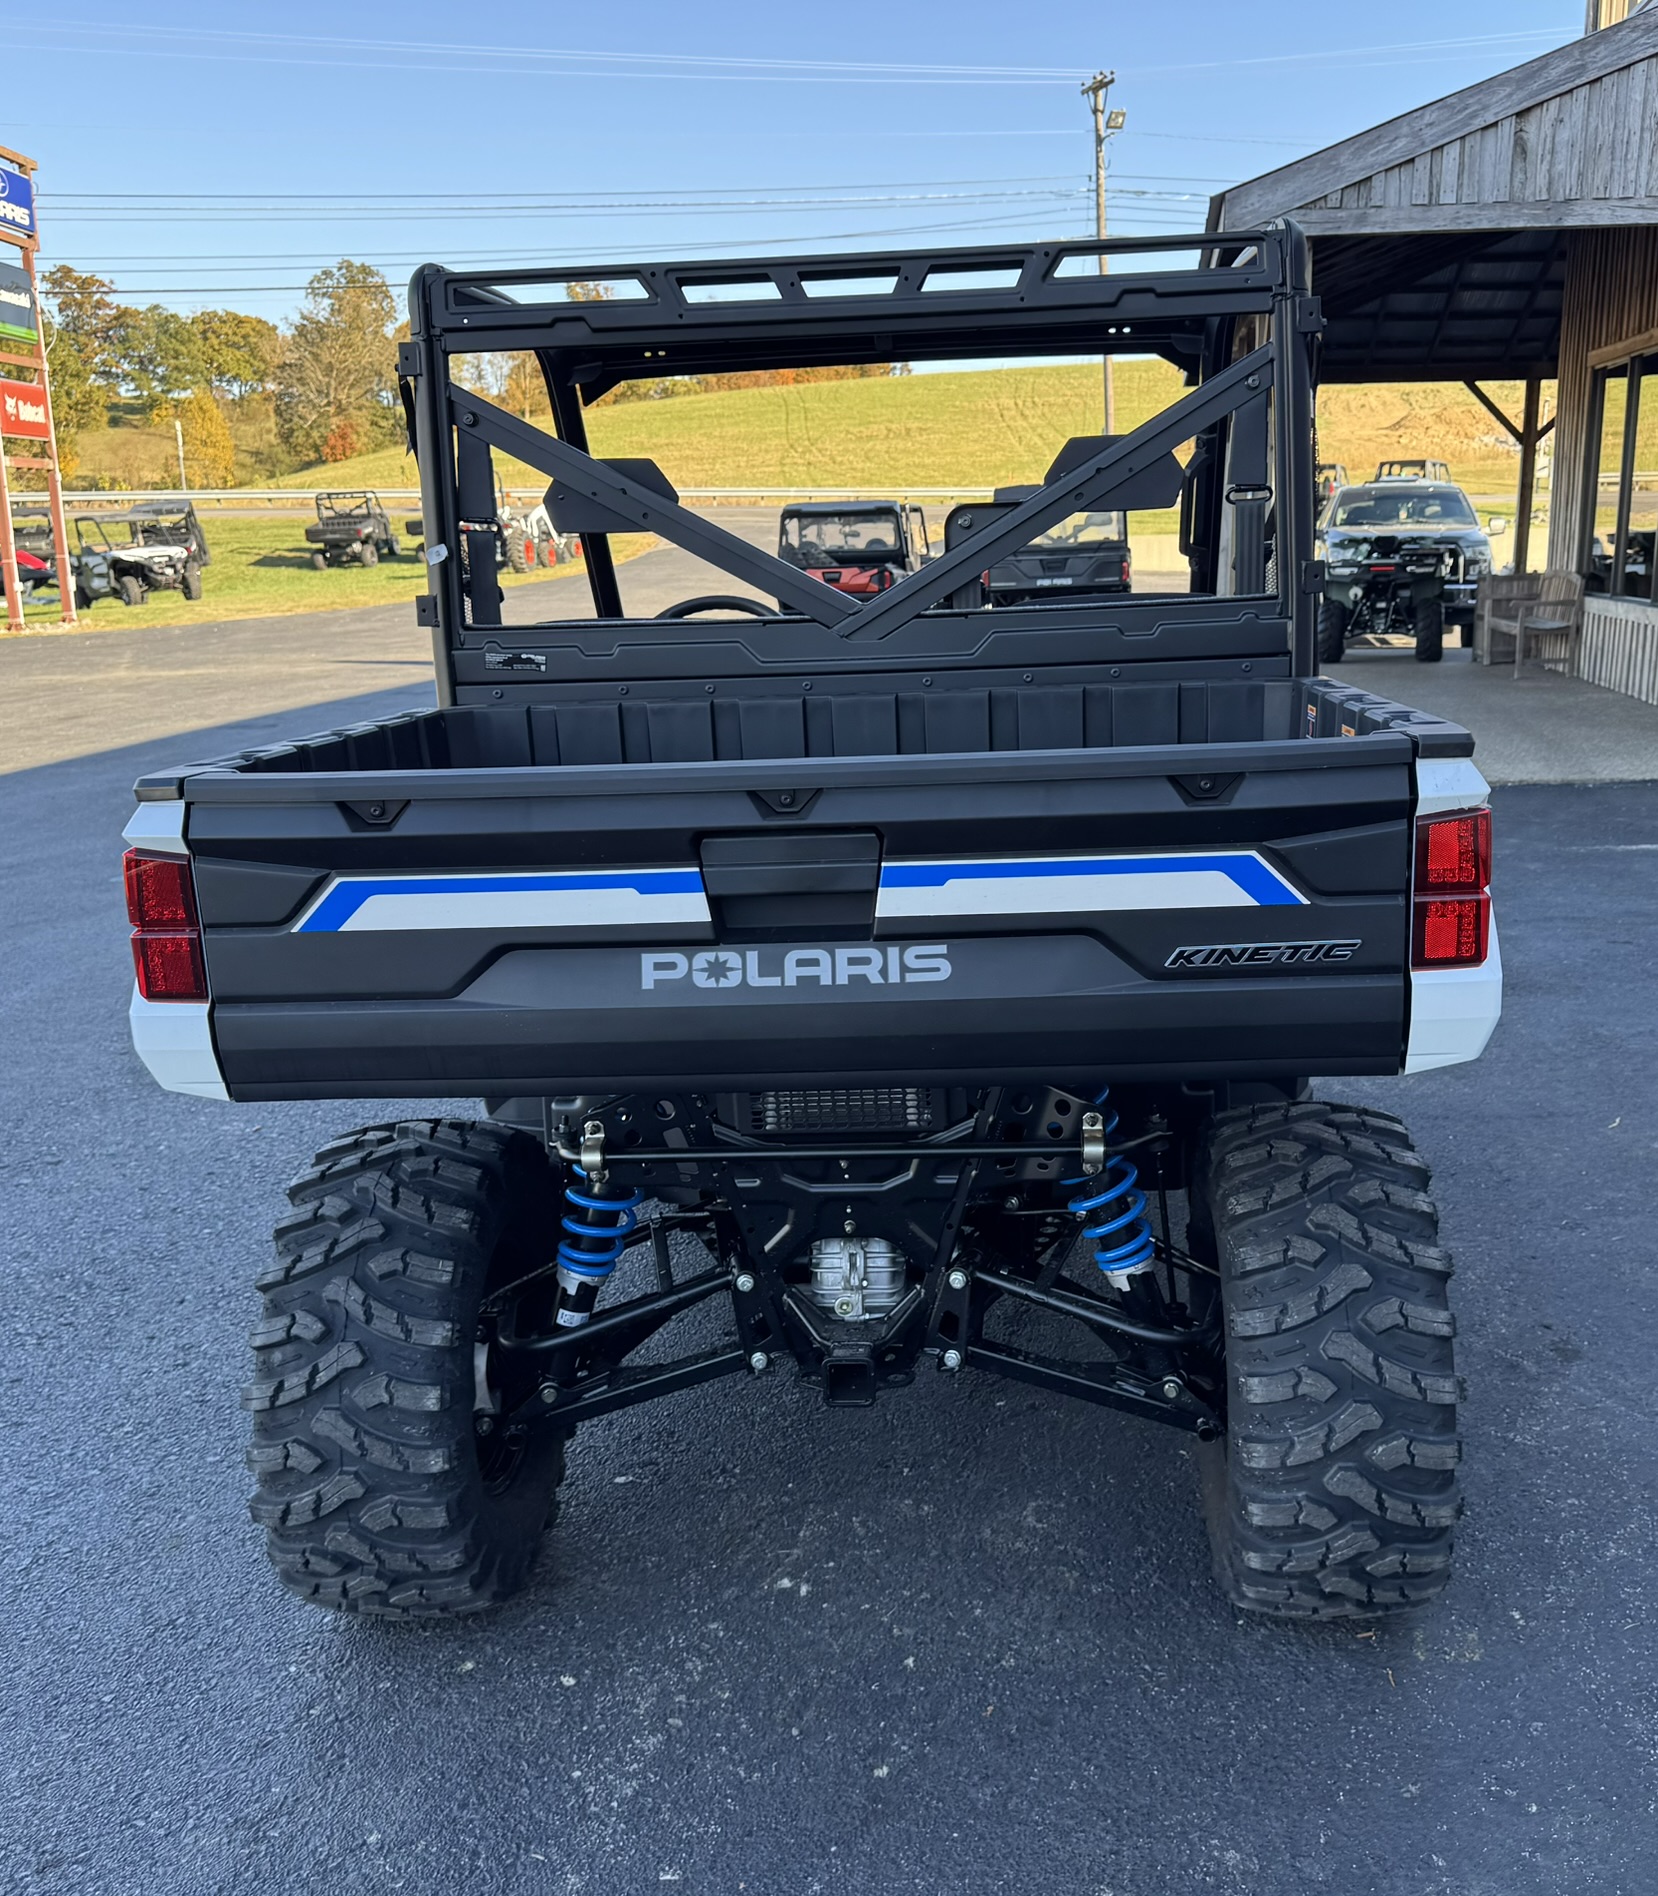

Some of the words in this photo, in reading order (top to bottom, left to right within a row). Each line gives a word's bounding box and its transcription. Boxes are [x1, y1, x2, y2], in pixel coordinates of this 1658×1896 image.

[17, 399, 47, 424] Bobcat
[641, 944, 952, 990] POLARIS
[1164, 939, 1362, 968] KINETIC
